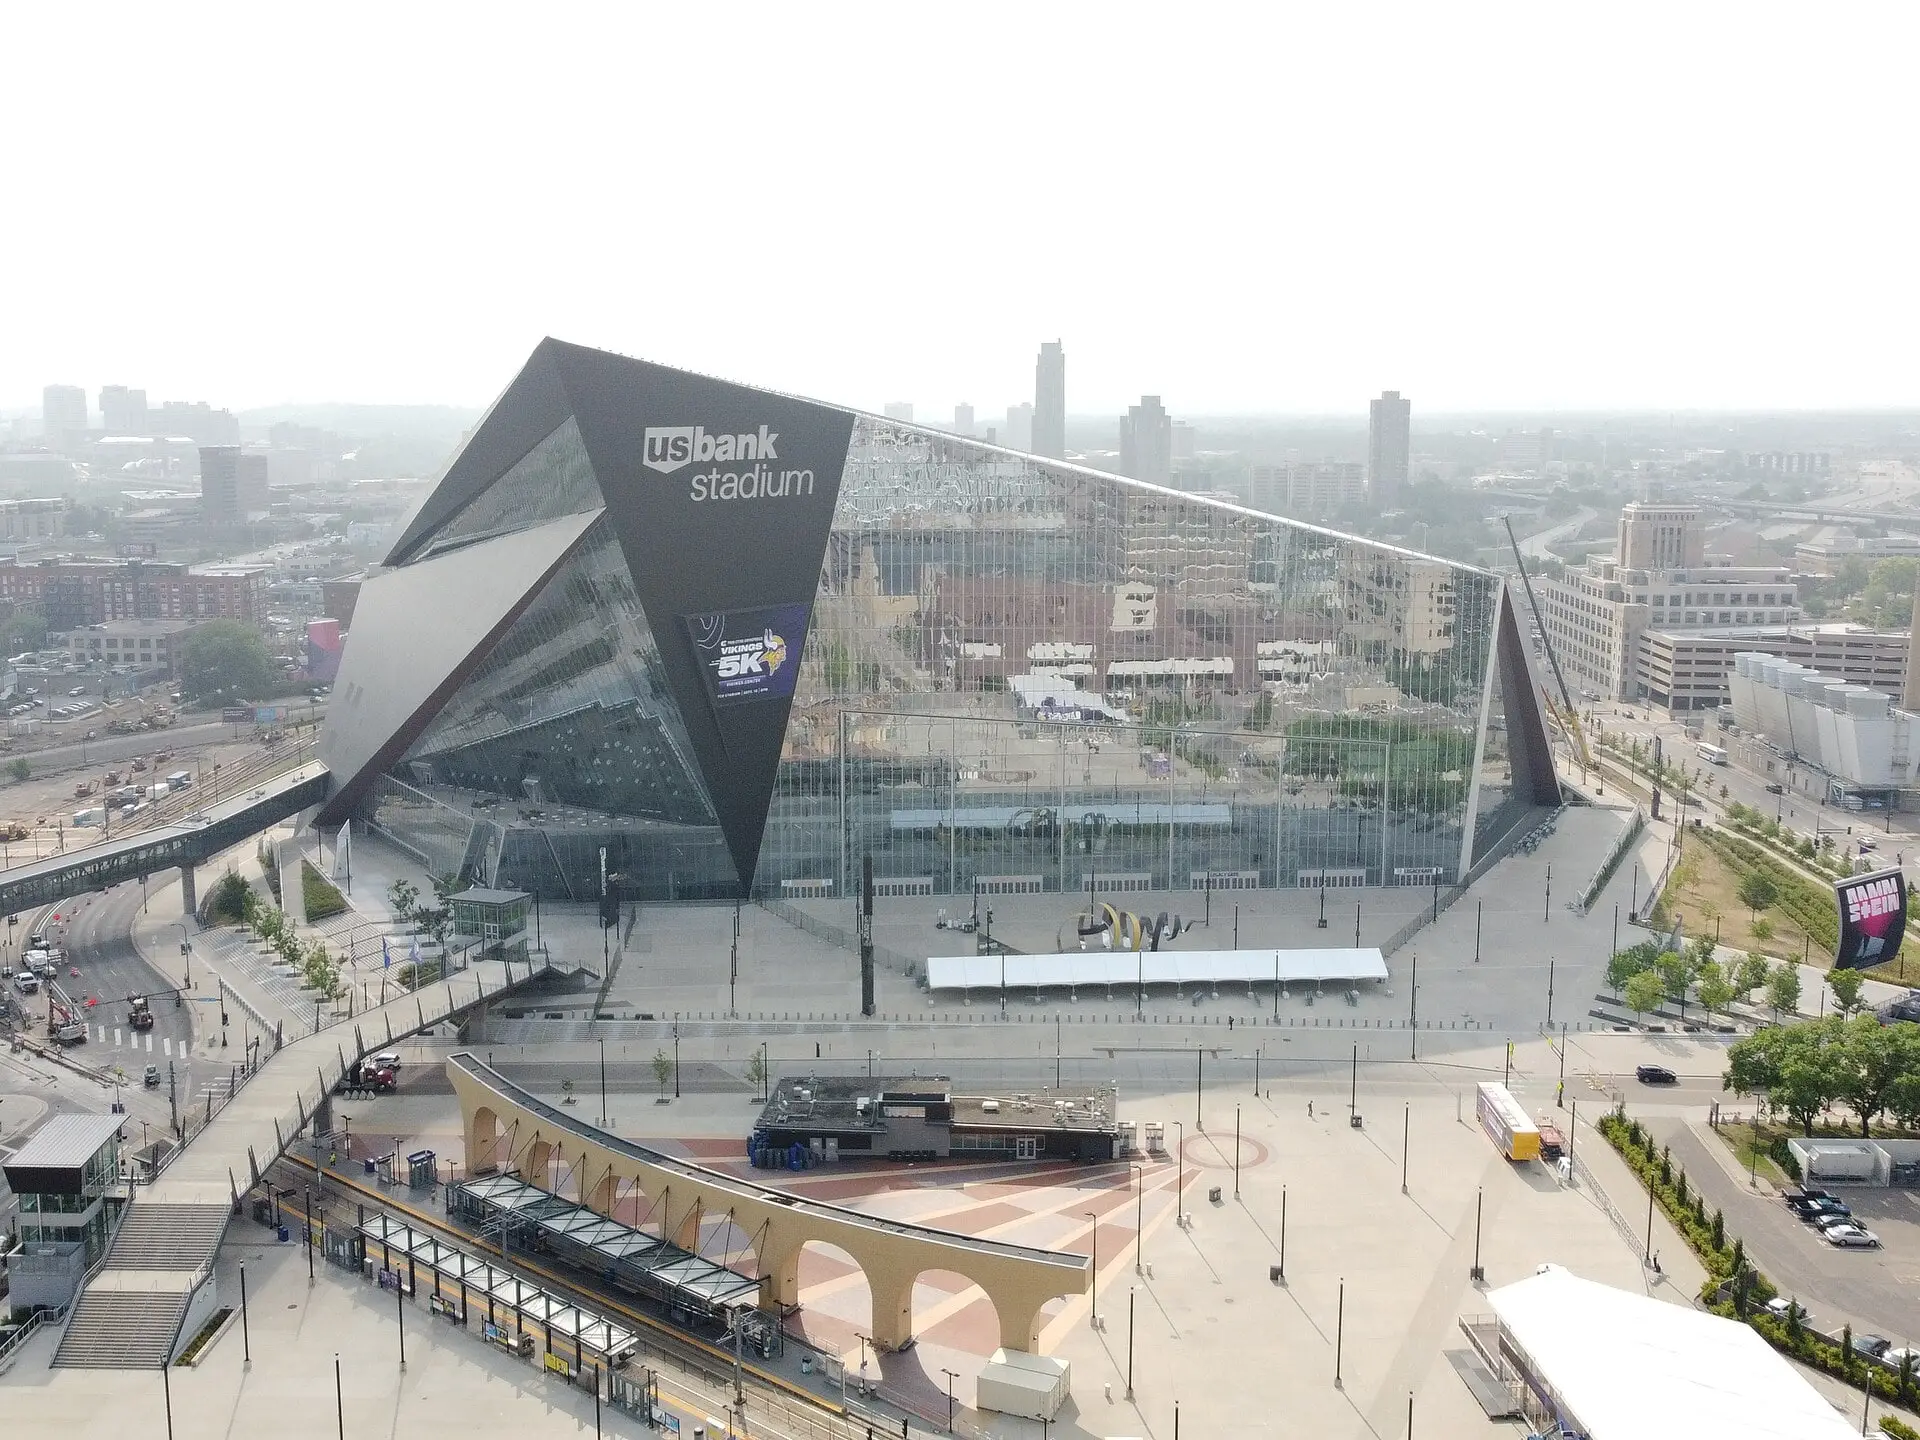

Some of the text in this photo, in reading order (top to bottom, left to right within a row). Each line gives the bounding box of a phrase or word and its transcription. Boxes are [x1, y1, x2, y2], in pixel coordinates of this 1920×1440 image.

[690, 464, 814, 502] stadium
[720, 642, 763, 655] VIKINGS
[718, 651, 764, 677] 5K
[1845, 877, 1898, 904] RAMM
[1849, 893, 1901, 923] STEIN
